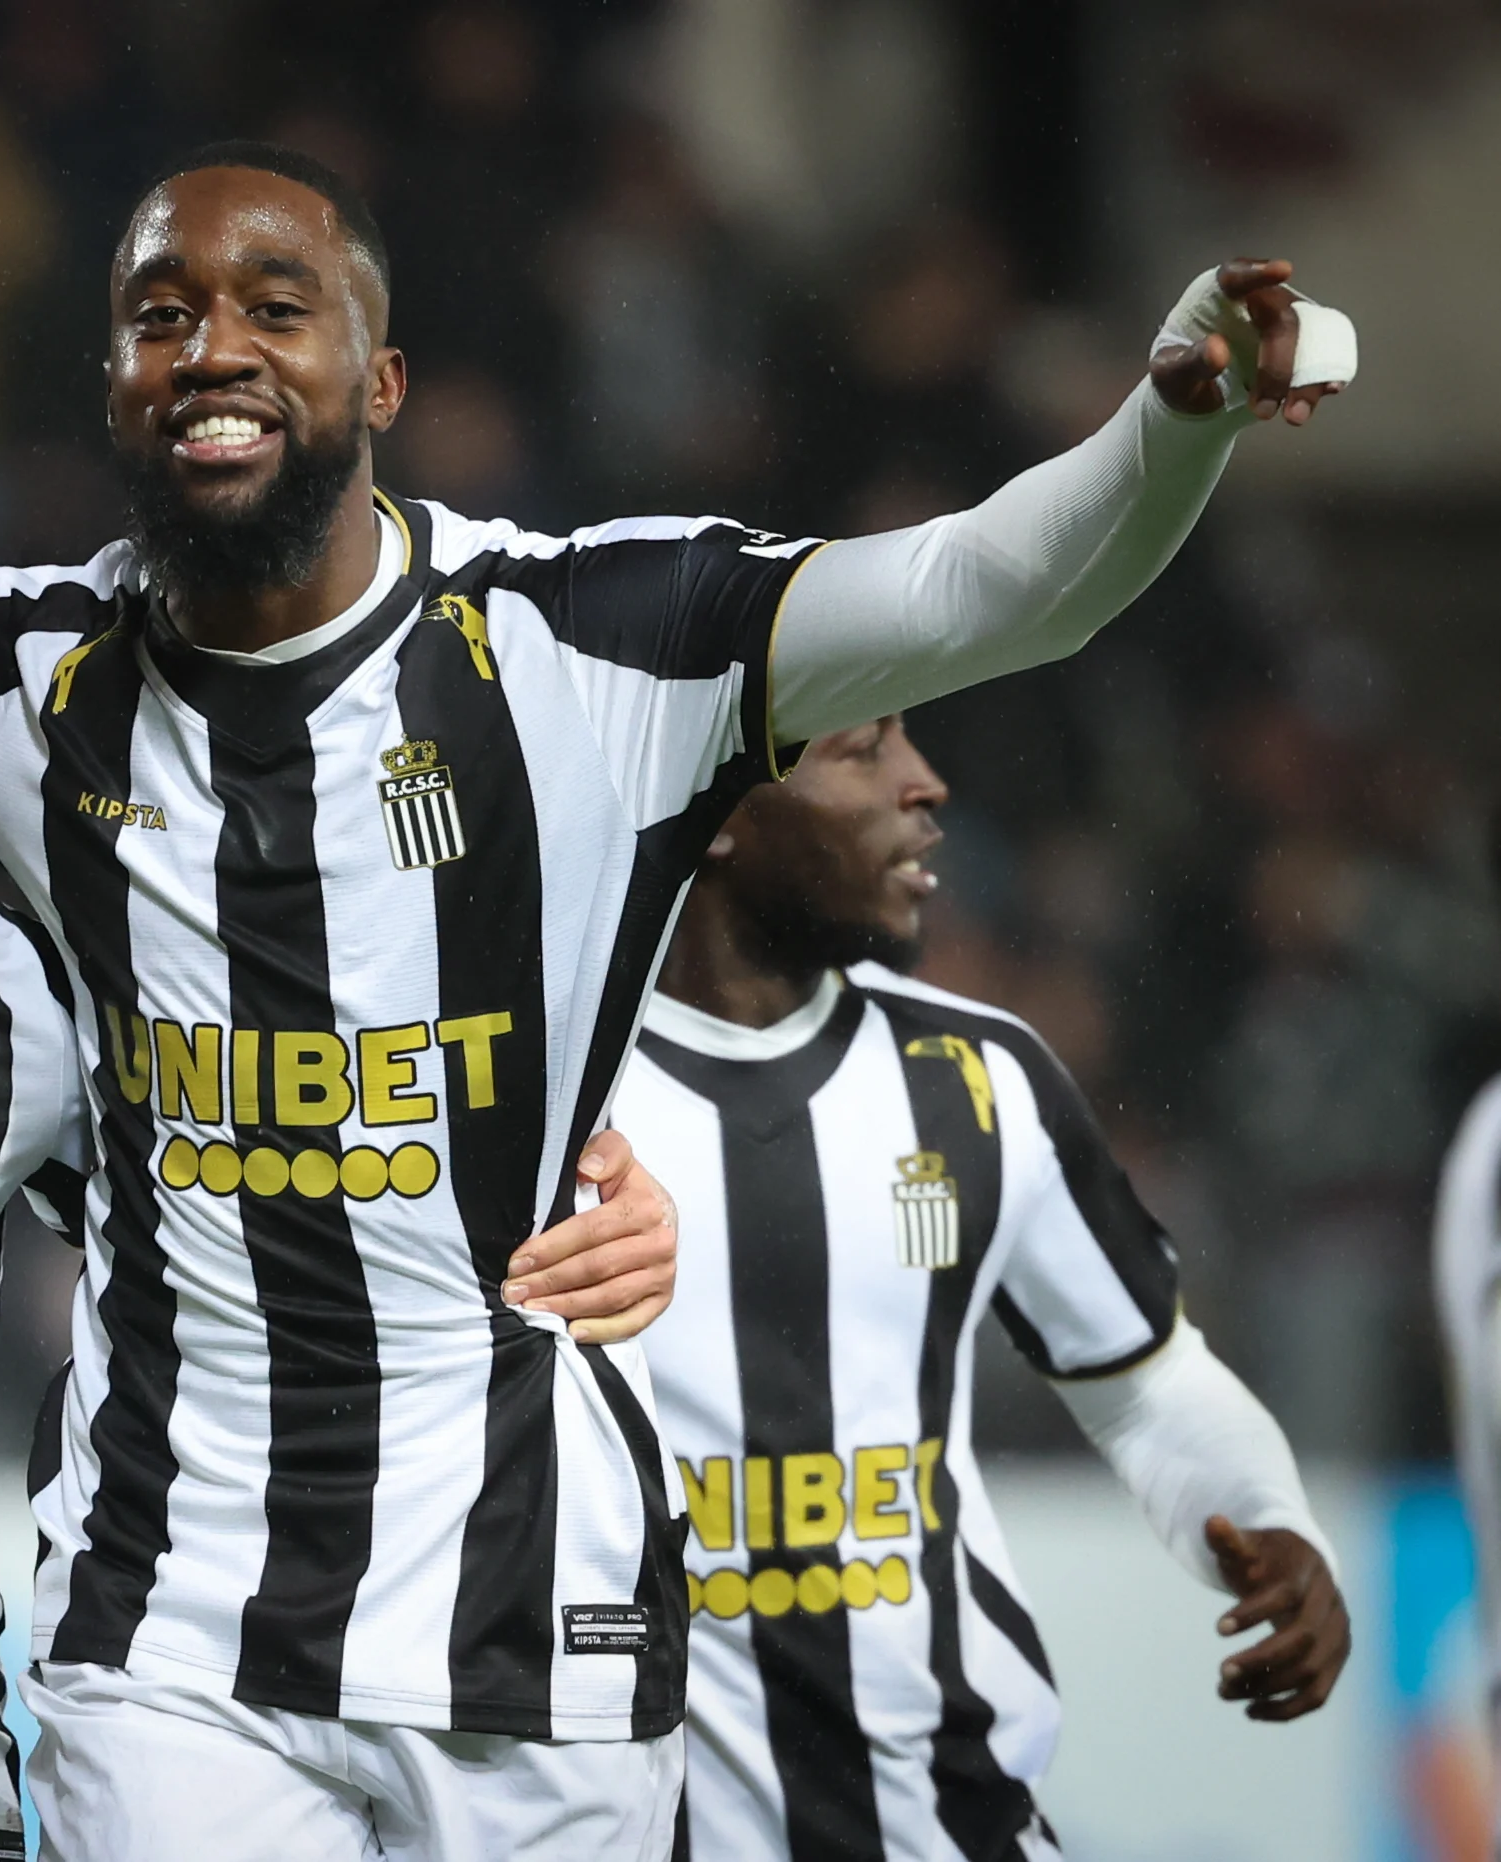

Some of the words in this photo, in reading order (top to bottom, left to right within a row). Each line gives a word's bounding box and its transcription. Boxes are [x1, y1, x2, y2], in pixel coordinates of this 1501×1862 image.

[385, 772, 445, 798] R.C.S.C.
[77, 791, 167, 830] KIPSTA
[104, 1001, 513, 1128] UNIBET
[677, 1438, 943, 1550] NIBET
[574, 1635, 601, 1645] KIPSTA
